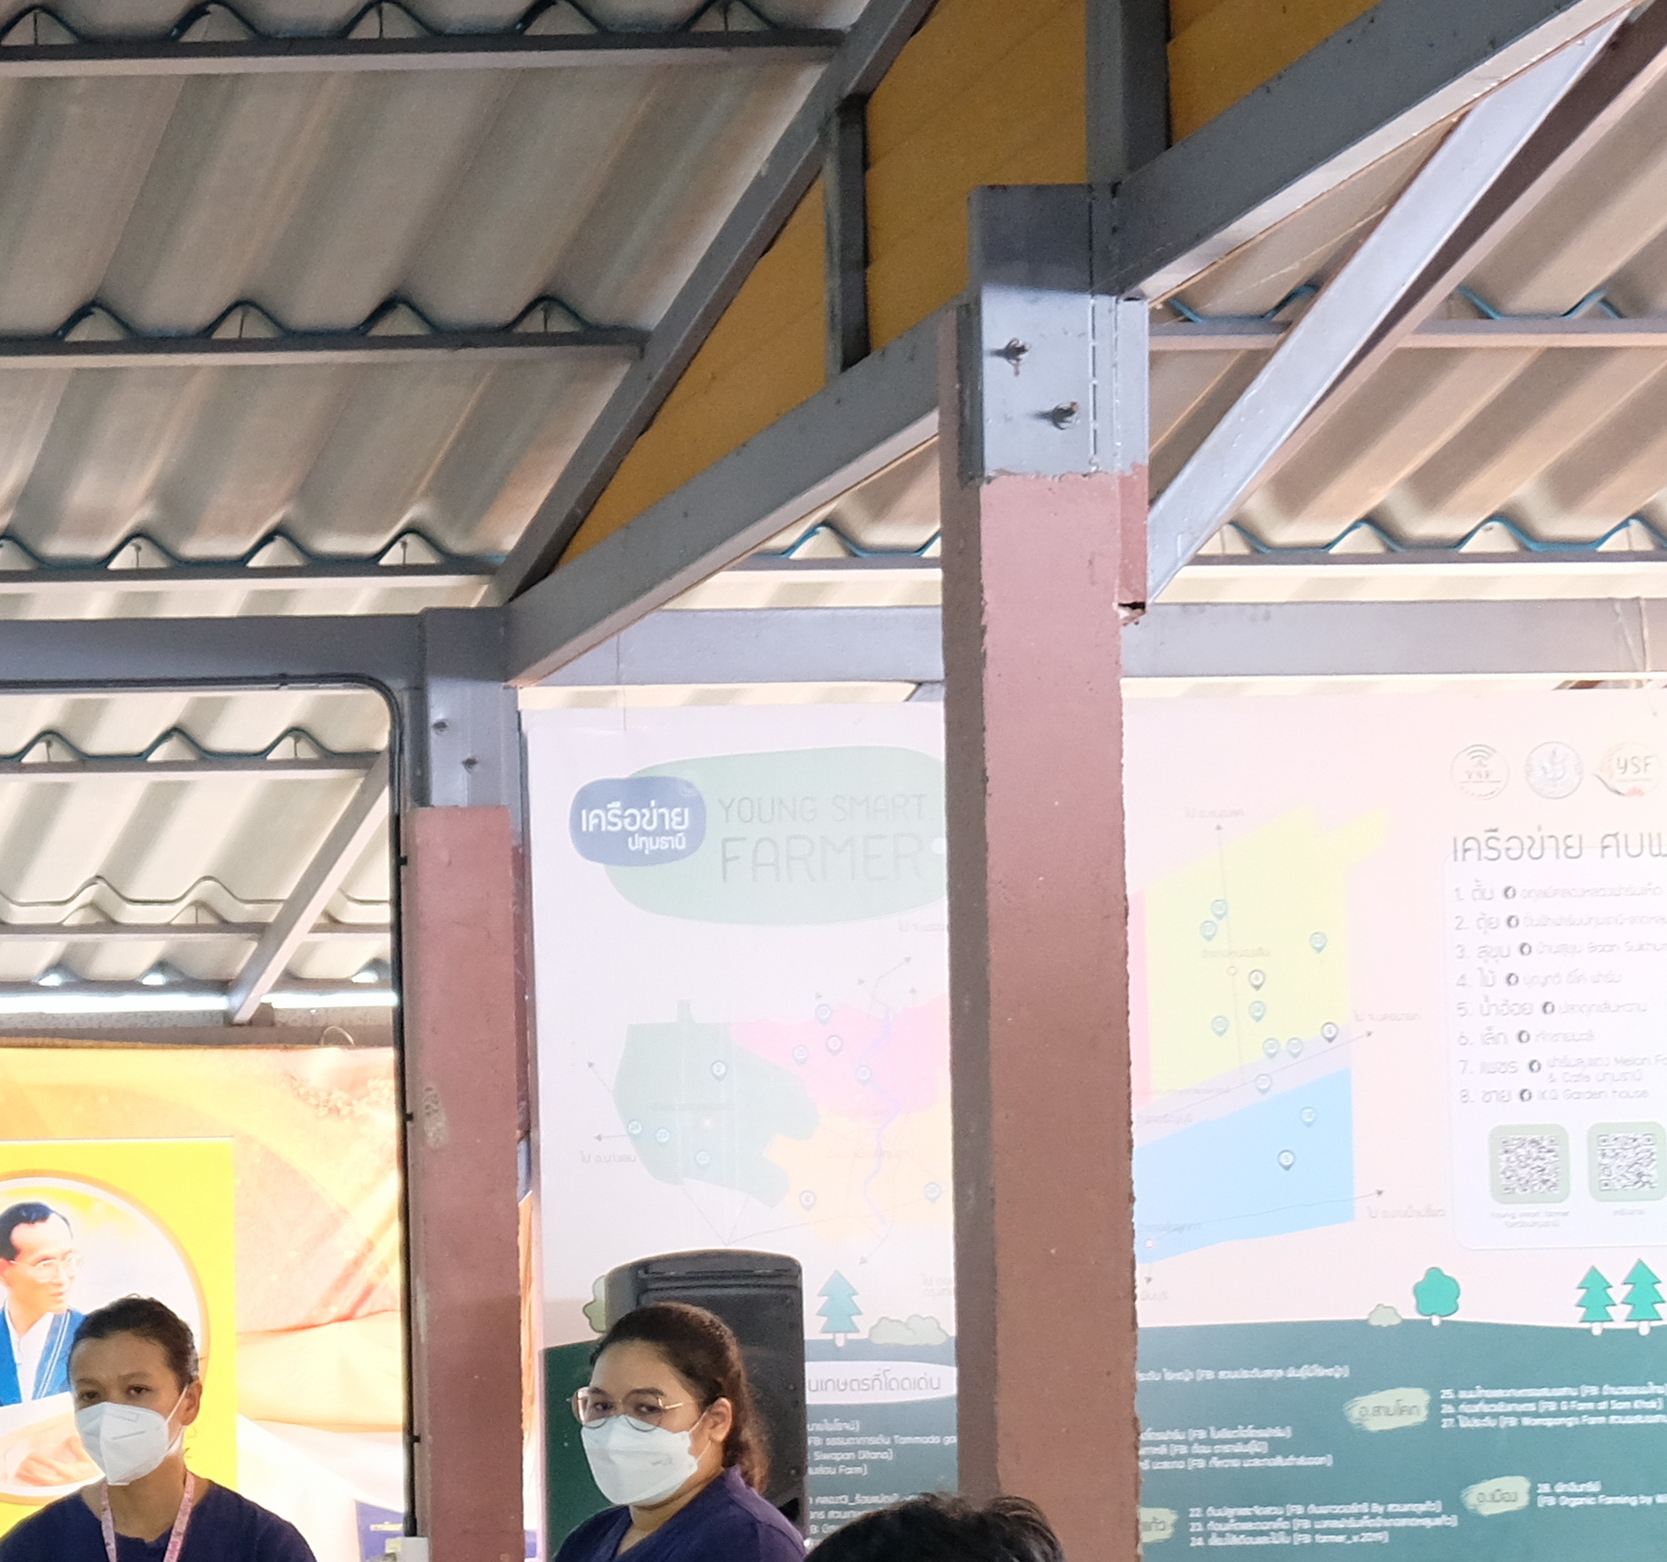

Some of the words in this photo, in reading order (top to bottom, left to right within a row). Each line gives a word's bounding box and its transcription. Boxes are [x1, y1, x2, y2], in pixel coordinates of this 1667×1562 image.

[581, 799, 689, 834] เครือข่าย
[718, 796, 818, 824] YOUNG
[831, 793, 927, 822] SMART
[628, 833, 686, 855] ปทุมธานี
[721, 832, 924, 883] FARMER
[1452, 824, 1584, 862] เครือข่าย
[808, 1367, 941, 1393] นเกษตรที่โดดเด่น
[1358, 1399, 1421, 1418] อ.สามโคก
